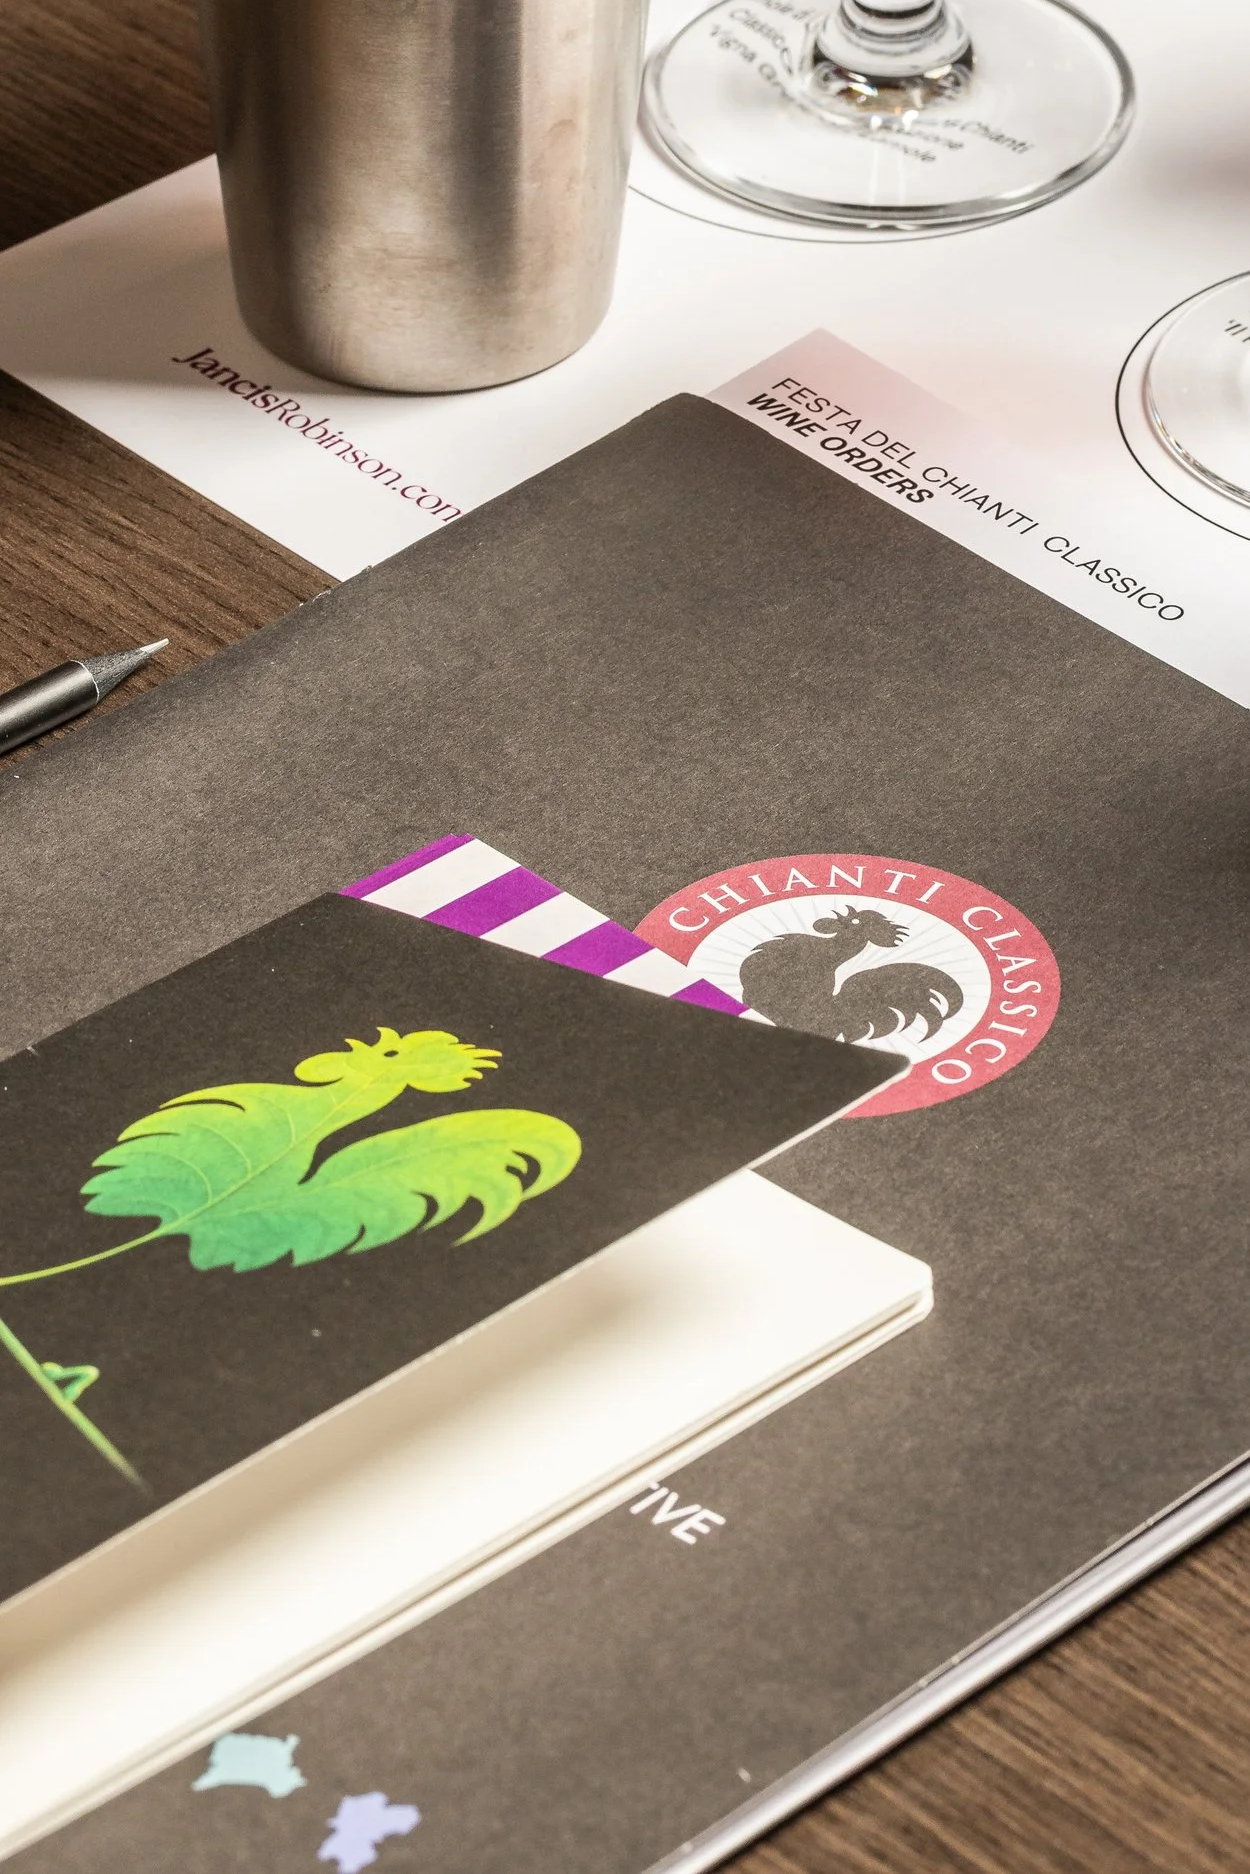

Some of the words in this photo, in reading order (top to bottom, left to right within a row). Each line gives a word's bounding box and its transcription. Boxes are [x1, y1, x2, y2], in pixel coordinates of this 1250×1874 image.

[746, 392, 828, 438] WINE
[820, 436, 935, 504] ORDERS
[771, 377, 863, 435] FESTA
[861, 430, 917, 470] DEL
[922, 466, 1039, 535] CHIANTI
[1043, 536, 1185, 621] CLASSICO
[668, 864, 946, 933] CHIANTI
[931, 905, 1042, 1086] CLASSICO
